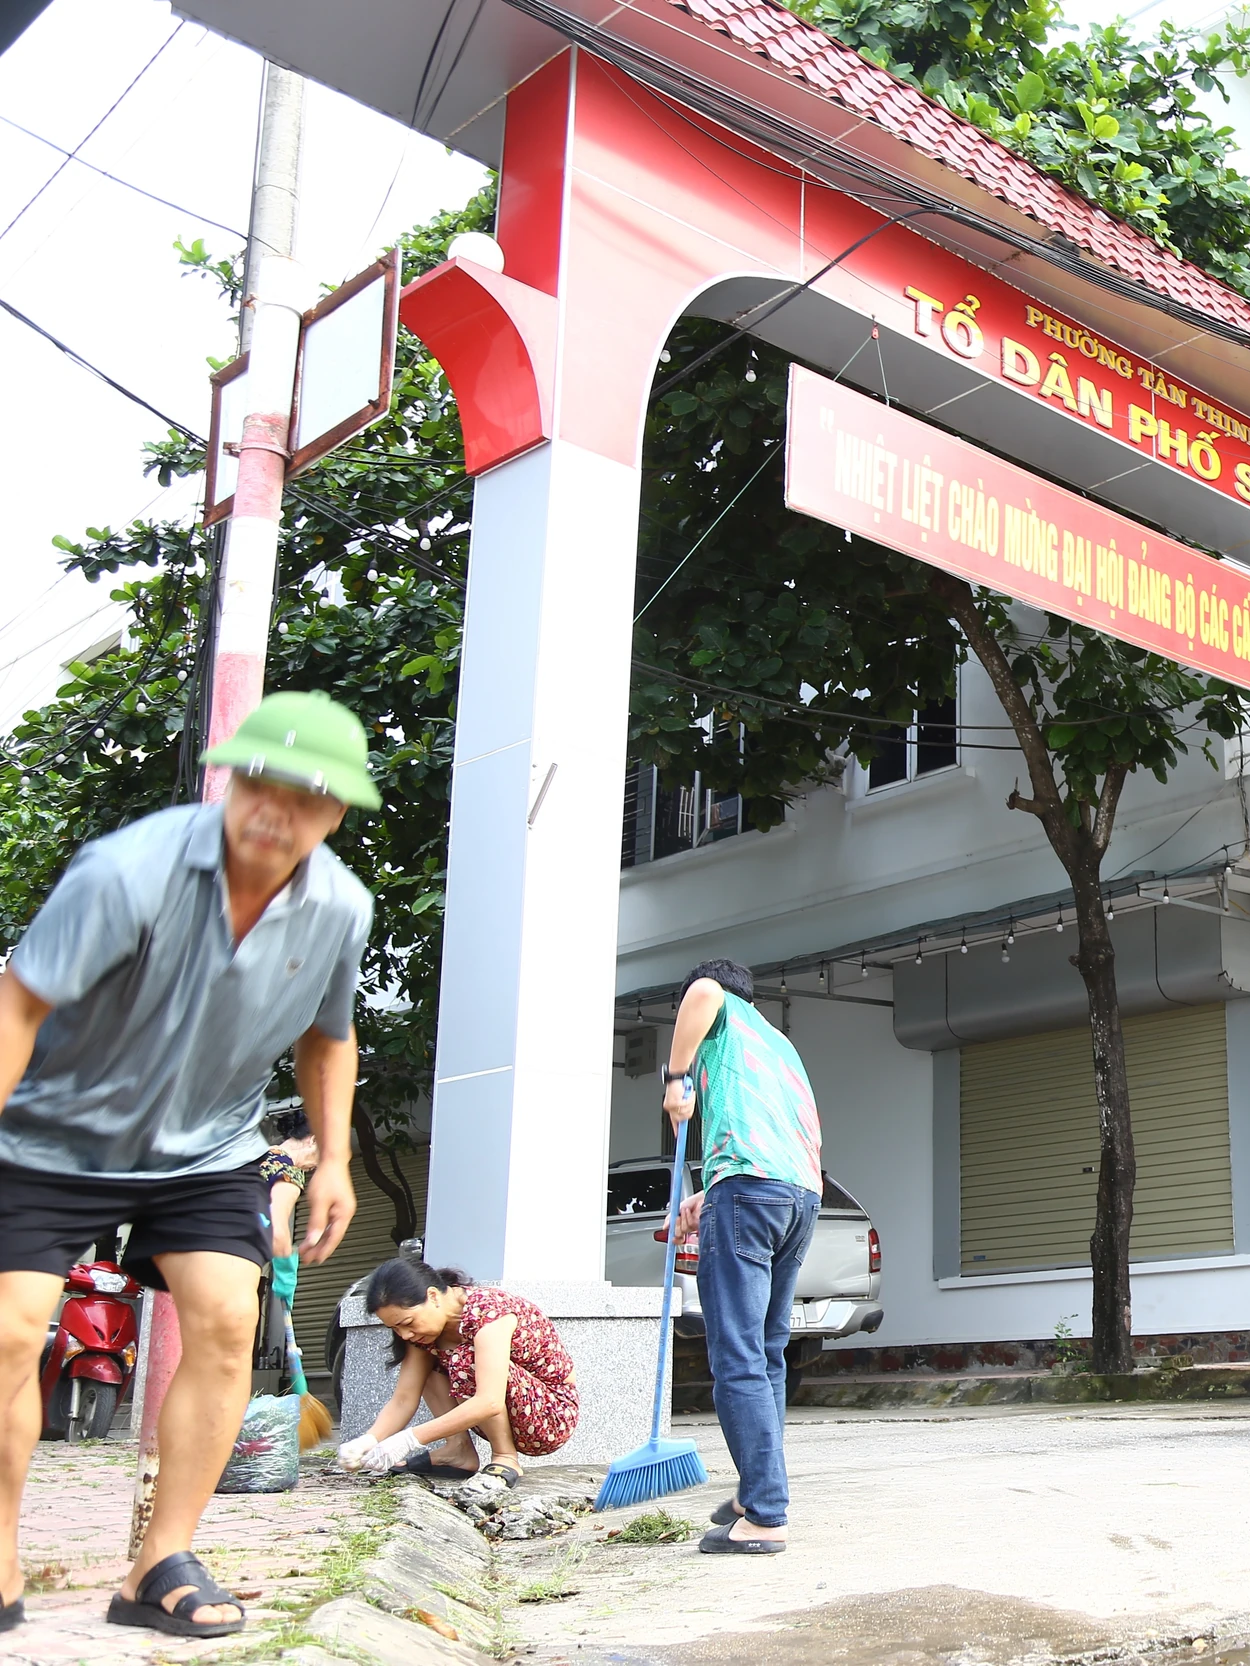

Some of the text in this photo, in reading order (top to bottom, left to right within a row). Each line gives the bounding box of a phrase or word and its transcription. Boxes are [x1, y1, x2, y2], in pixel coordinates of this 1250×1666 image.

[904, 285, 984, 359] TỔ
[1002, 336, 1113, 430] DÂN
[1128, 403, 1222, 481] PHỐ
[1025, 304, 1134, 380] PHƯỜNG
[1138, 367, 1188, 410] TÂN
[901, 454, 944, 543] LIỆT
[948, 478, 1000, 558] CHÀO
[1004, 497, 1059, 583] MỪNG
[1062, 529, 1092, 607] ĐẠI
[1096, 538, 1124, 620] HỘI
[1128, 540, 1172, 630] ĐẢNG
[1175, 573, 1196, 652] BỘ
[1200, 584, 1229, 653] CÁC
